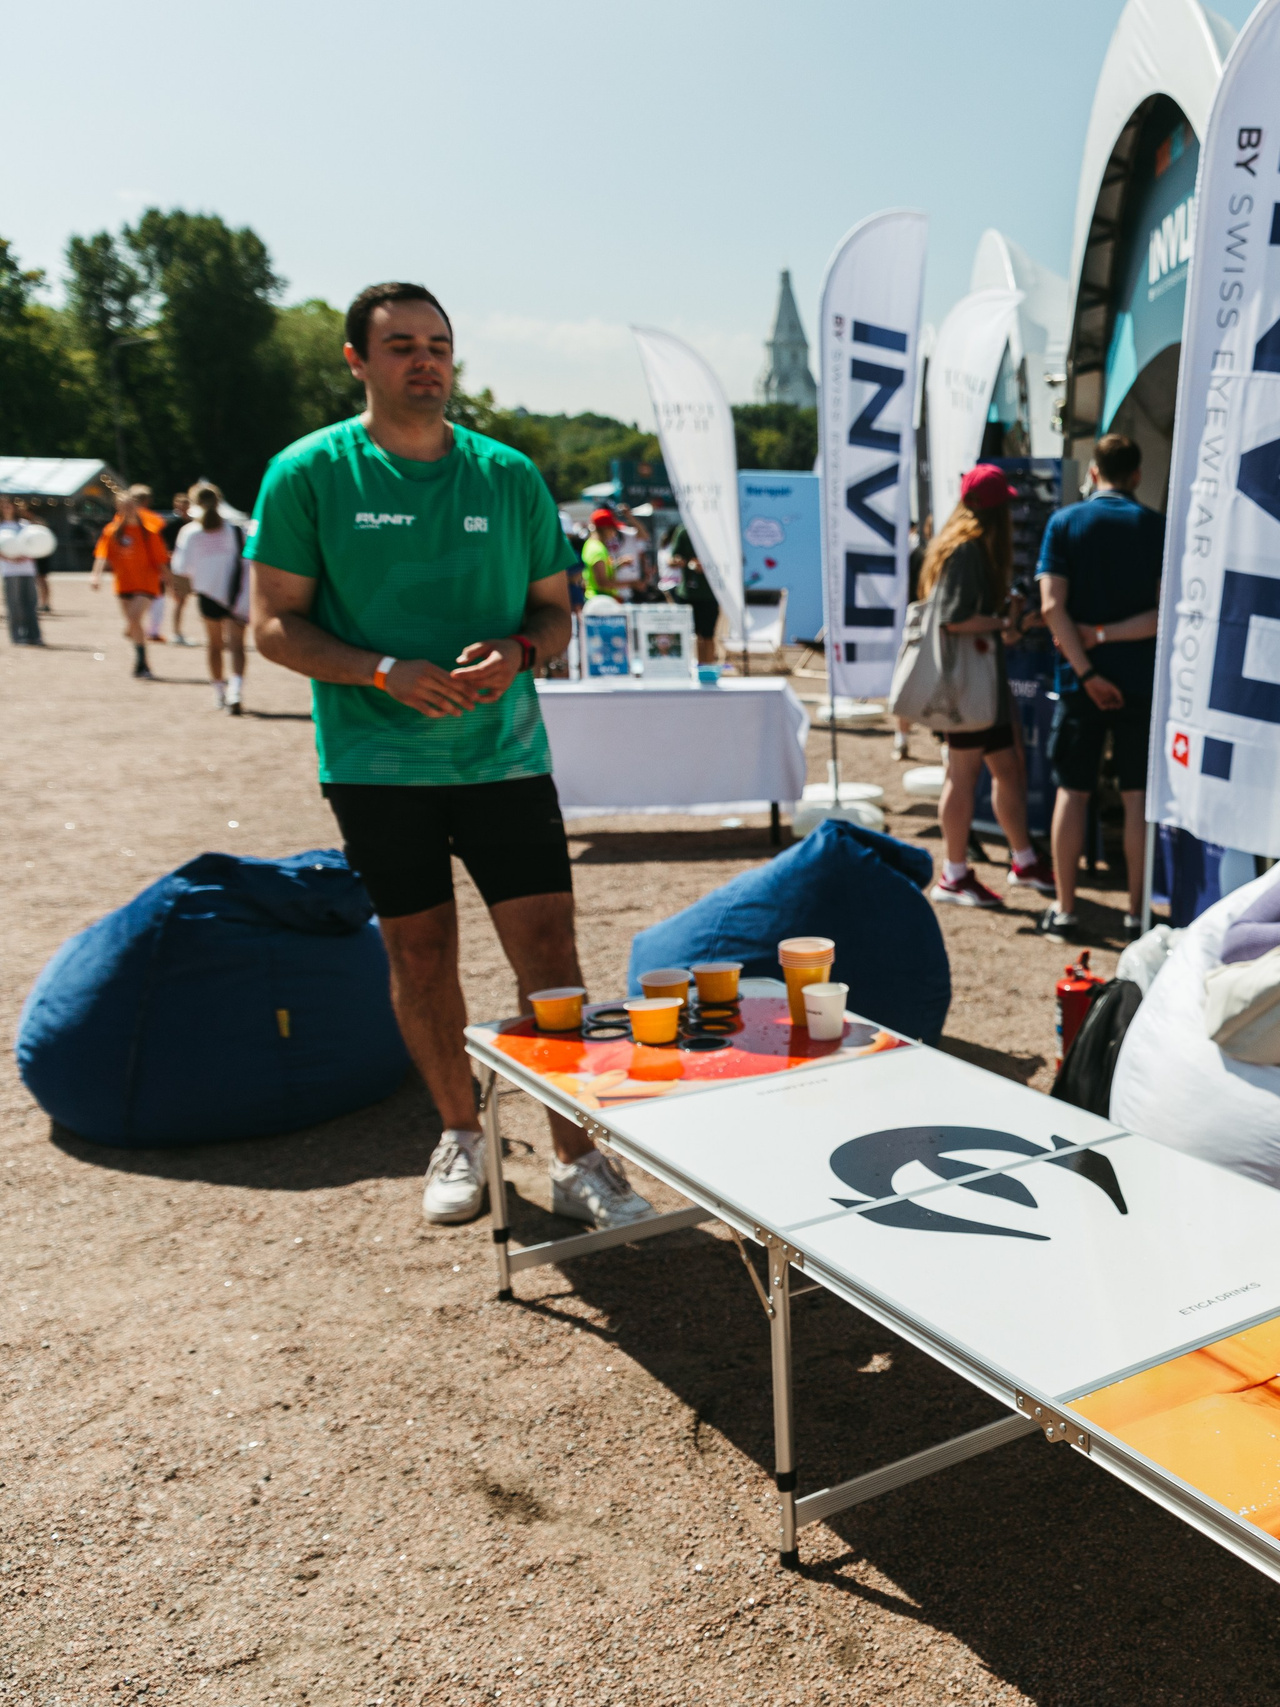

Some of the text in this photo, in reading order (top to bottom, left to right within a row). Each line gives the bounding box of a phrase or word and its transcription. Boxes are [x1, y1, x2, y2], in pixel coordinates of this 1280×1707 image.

[1175, 127, 1262, 720] BY SWISS EYEWEAR GROUP
[1179, 1282, 1261, 1315] ETICA DRINKS
